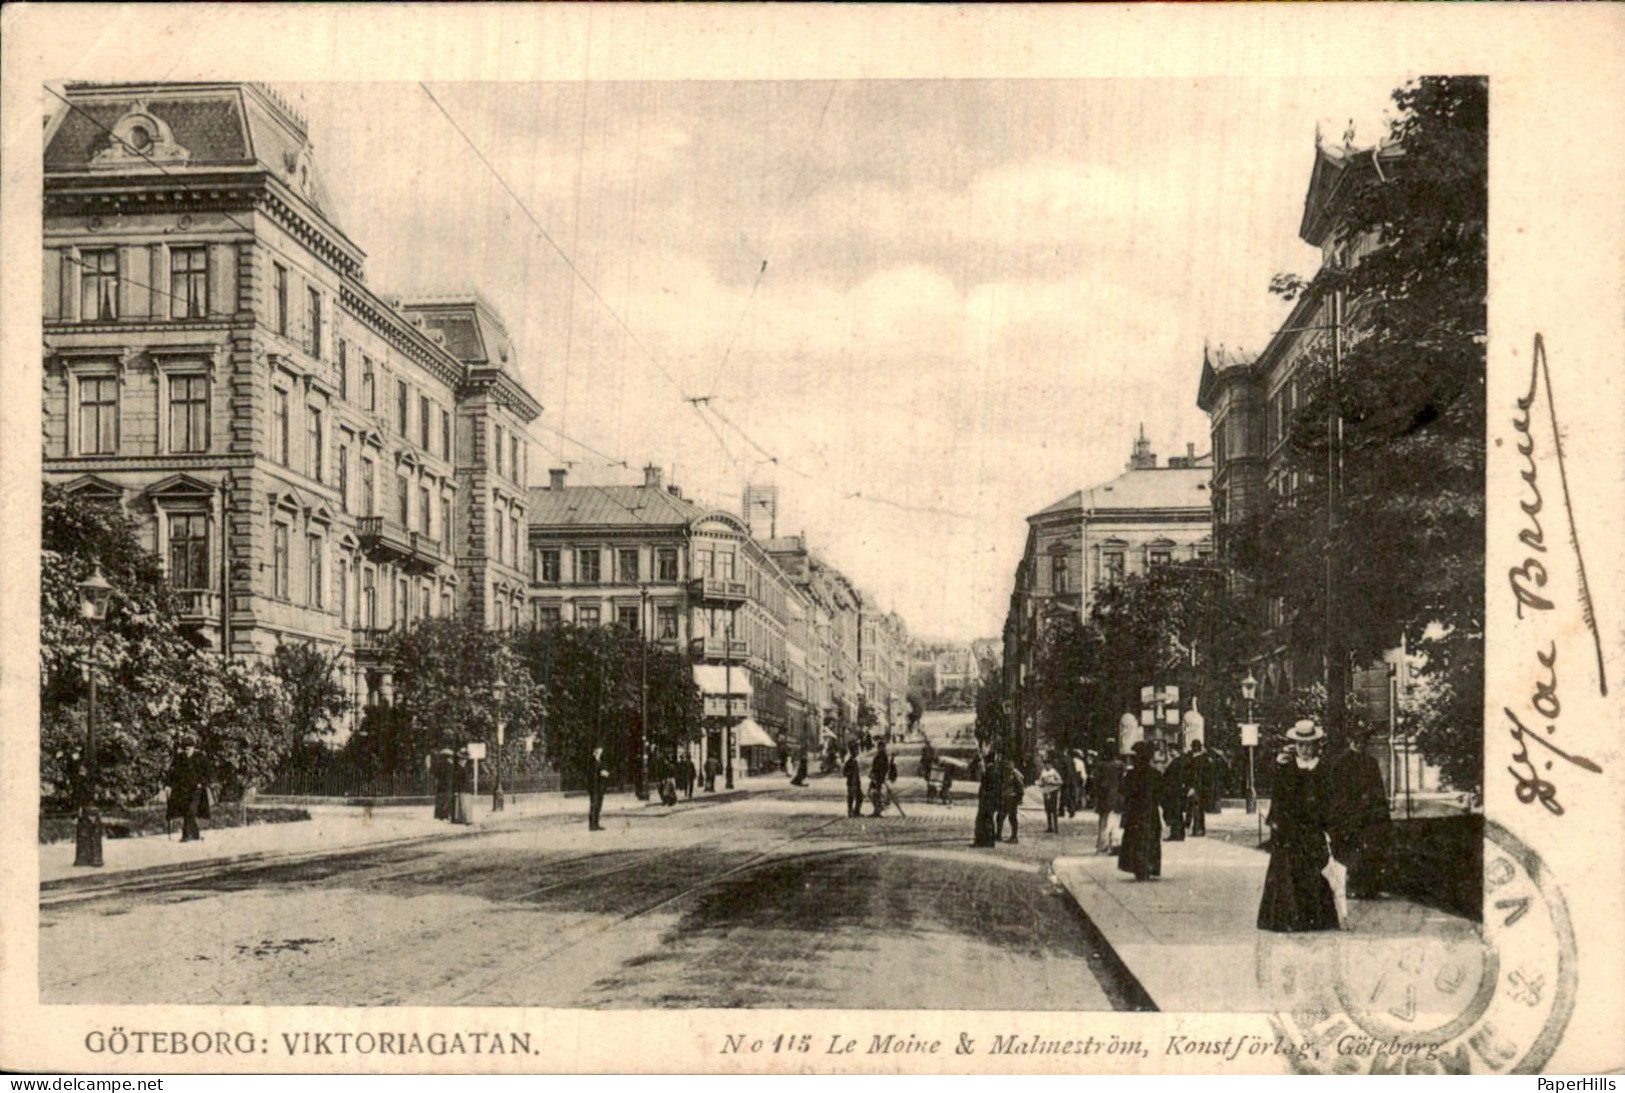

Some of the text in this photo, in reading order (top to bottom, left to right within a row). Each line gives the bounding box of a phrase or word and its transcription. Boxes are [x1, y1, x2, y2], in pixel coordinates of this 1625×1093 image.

[85, 1027, 539, 1055] GÖTEBORG: VIKTORIAGATAN.
[772, 1034, 811, 1054] 115
[826, 1034, 857, 1054] Le
[866, 1033, 940, 1054] Moine
[954, 1031, 975, 1055] &
[988, 1033, 1149, 1058] Malmeström,
[1165, 1034, 1322, 1060] Konstförlag,
